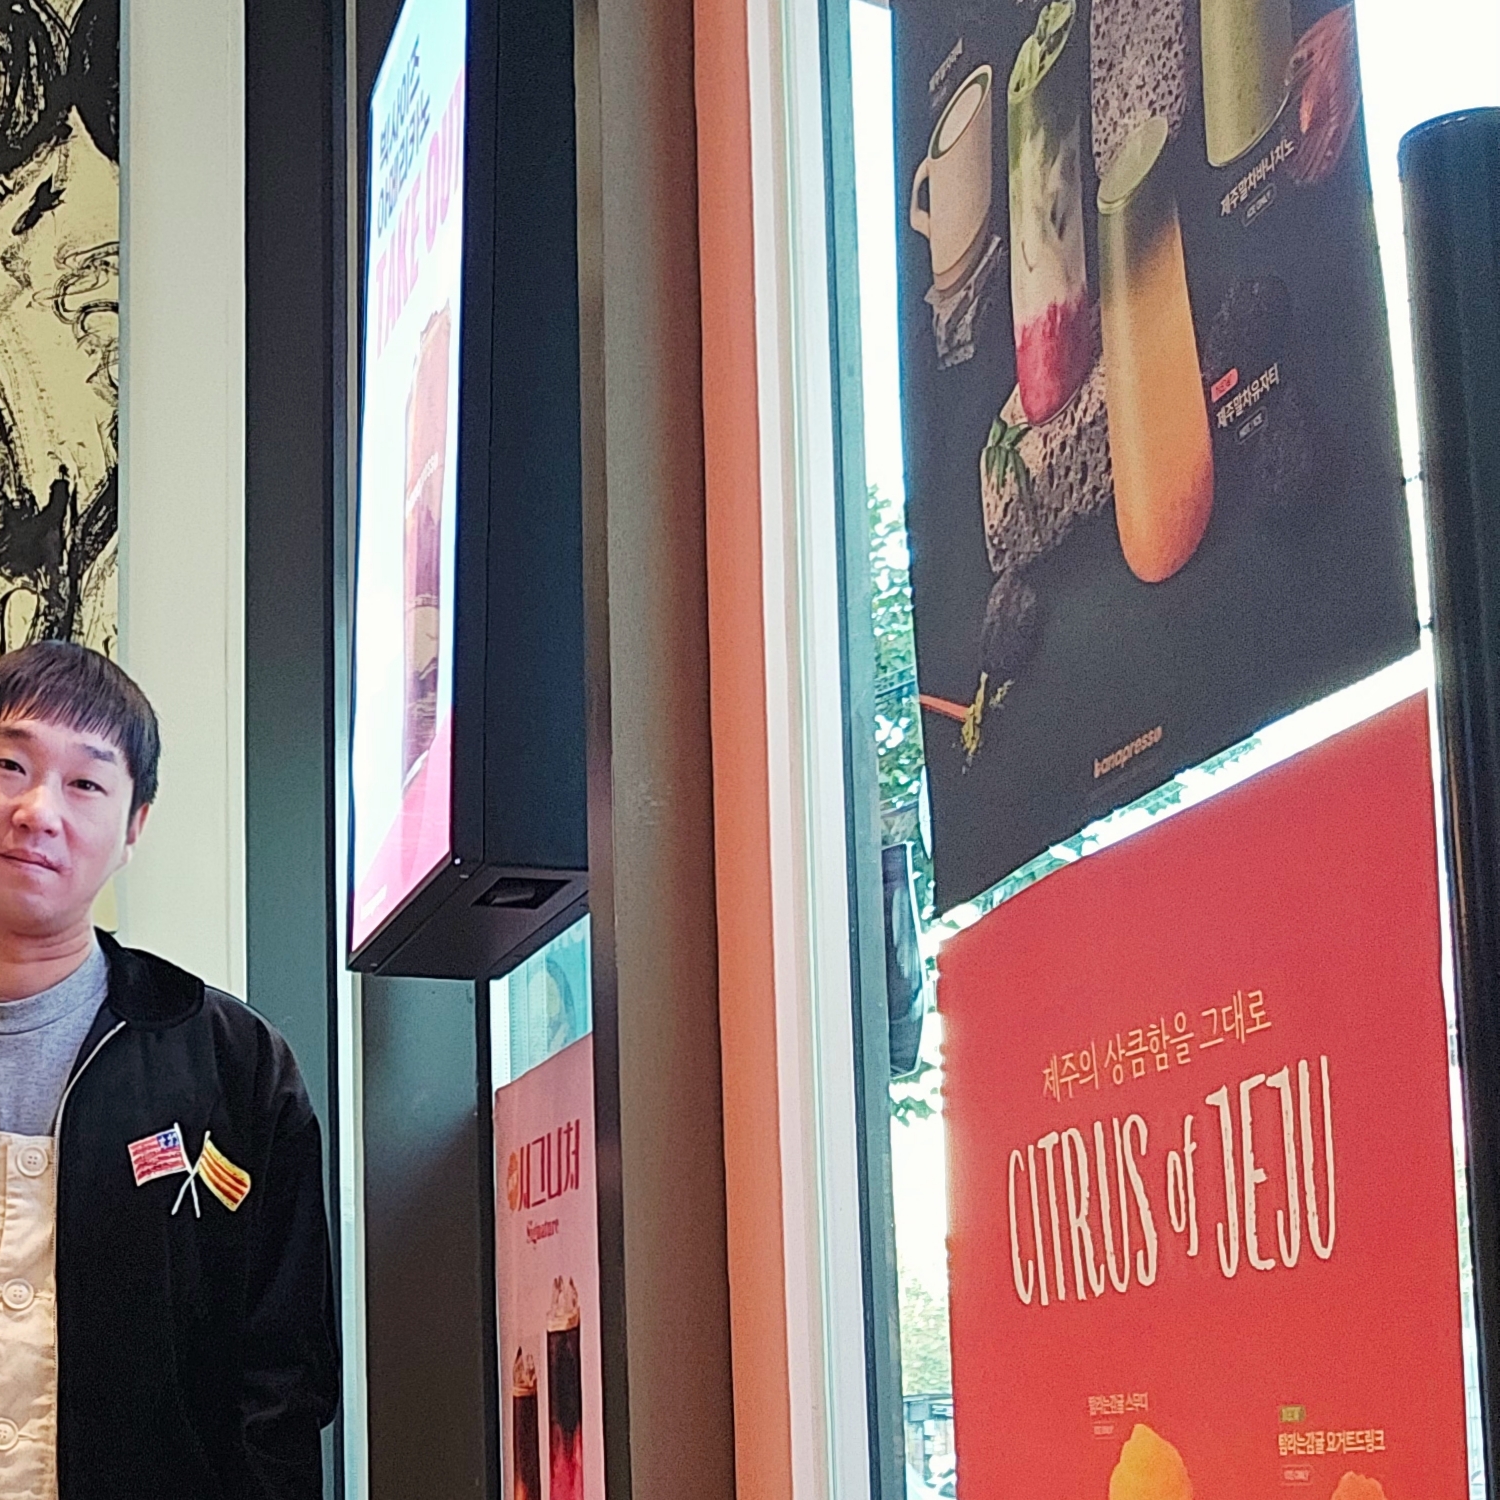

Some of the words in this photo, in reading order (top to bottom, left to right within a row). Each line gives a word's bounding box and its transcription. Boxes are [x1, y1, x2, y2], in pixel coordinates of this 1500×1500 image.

[377, 90, 431, 239] 아메리카노
[375, 170, 421, 361] TAKE
[425, 66, 464, 254] OUT
[1215, 362, 1280, 429] 제주말차유자티
[1093, 725, 1163, 779] banapresso
[1042, 1041, 1100, 1102] 제주의
[1103, 1010, 1195, 1086] 상큼함을
[1198, 989, 1273, 1049] 그대로
[518, 1118, 580, 1212] 시그니처
[1008, 1113, 1158, 1305] CITRUS
[1166, 1114, 1198, 1257] of
[1205, 1055, 1336, 1278] JEJU
[1125, 1391, 1149, 1411] 스무디
[1278, 1430, 1325, 1456] 탐라는감귤
[1326, 1428, 1386, 1454] 요거트드링크
